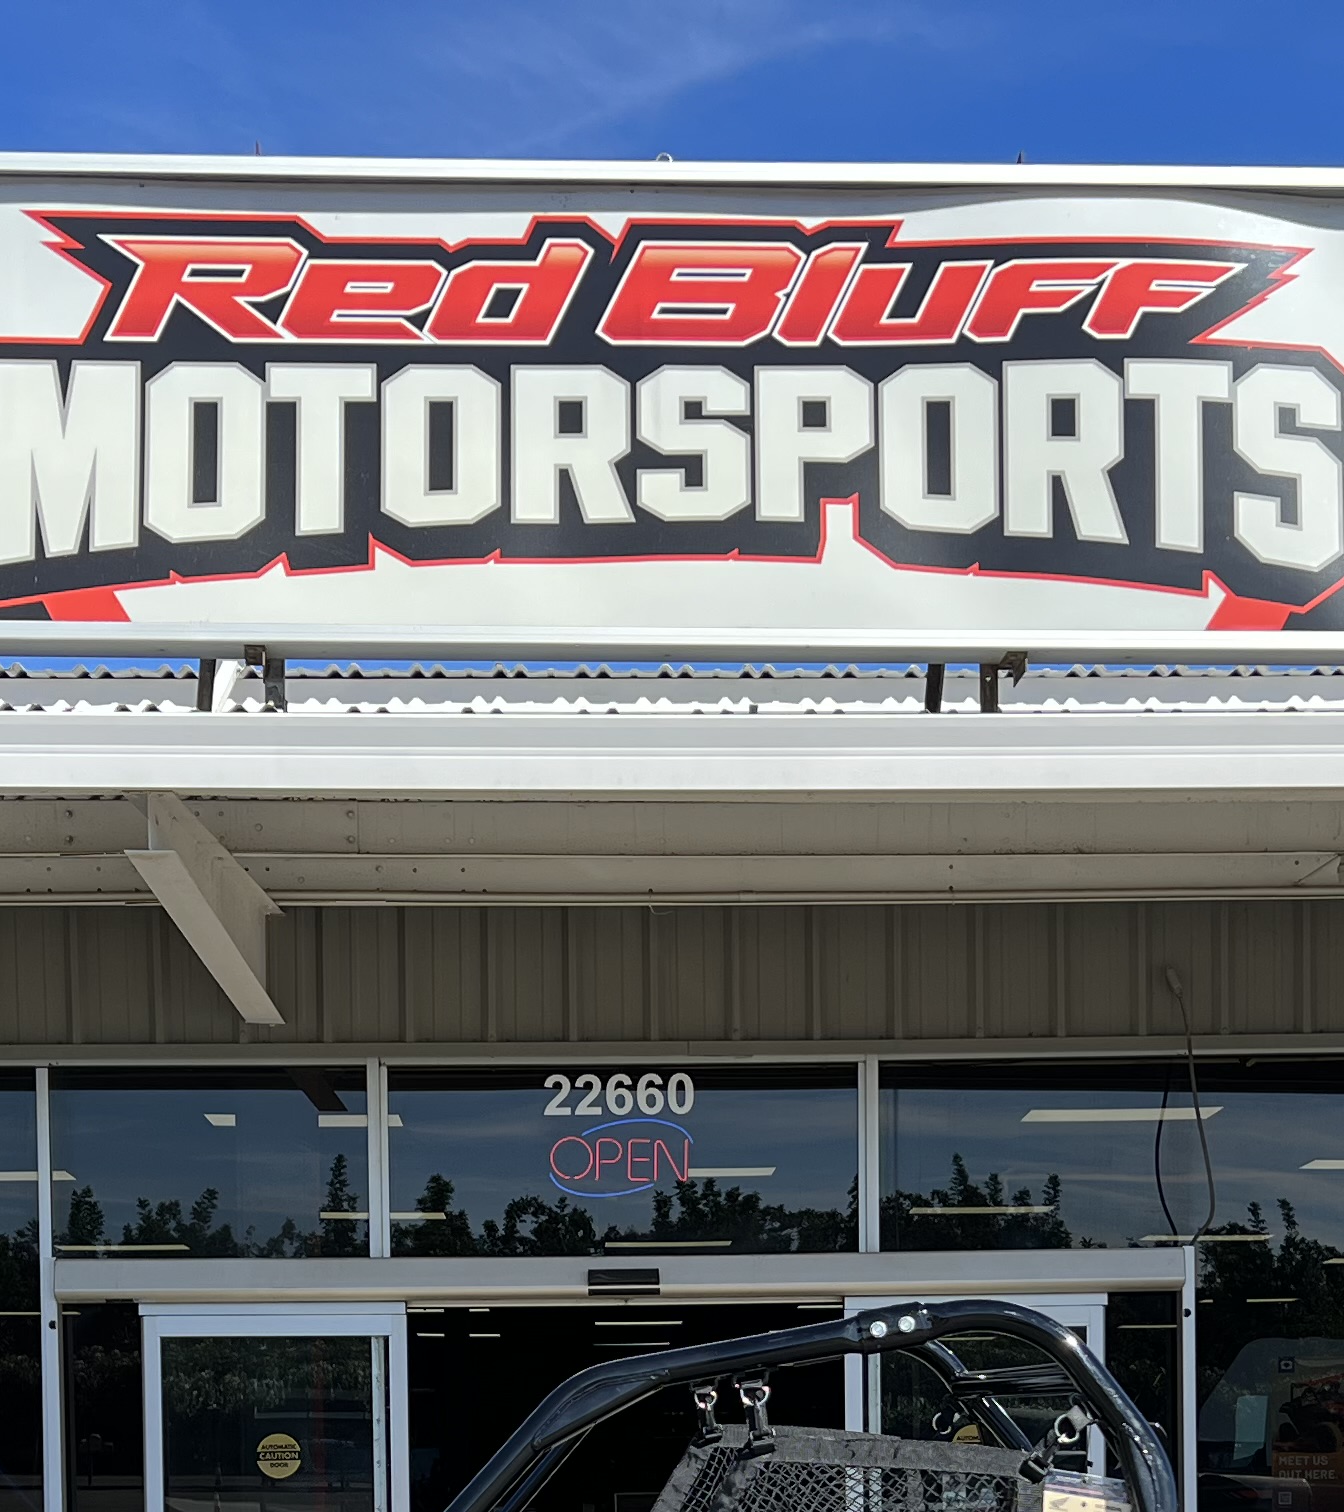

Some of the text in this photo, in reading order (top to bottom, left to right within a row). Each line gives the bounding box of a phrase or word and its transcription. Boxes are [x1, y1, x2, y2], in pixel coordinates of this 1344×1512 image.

[97, 234, 594, 345] Red
[543, 1072, 695, 1116] 22660
[549, 1135, 690, 1182] OPEN
[259, 1452, 299, 1460] CAUTION
[1278, 1456, 1329, 1466] MEET US
